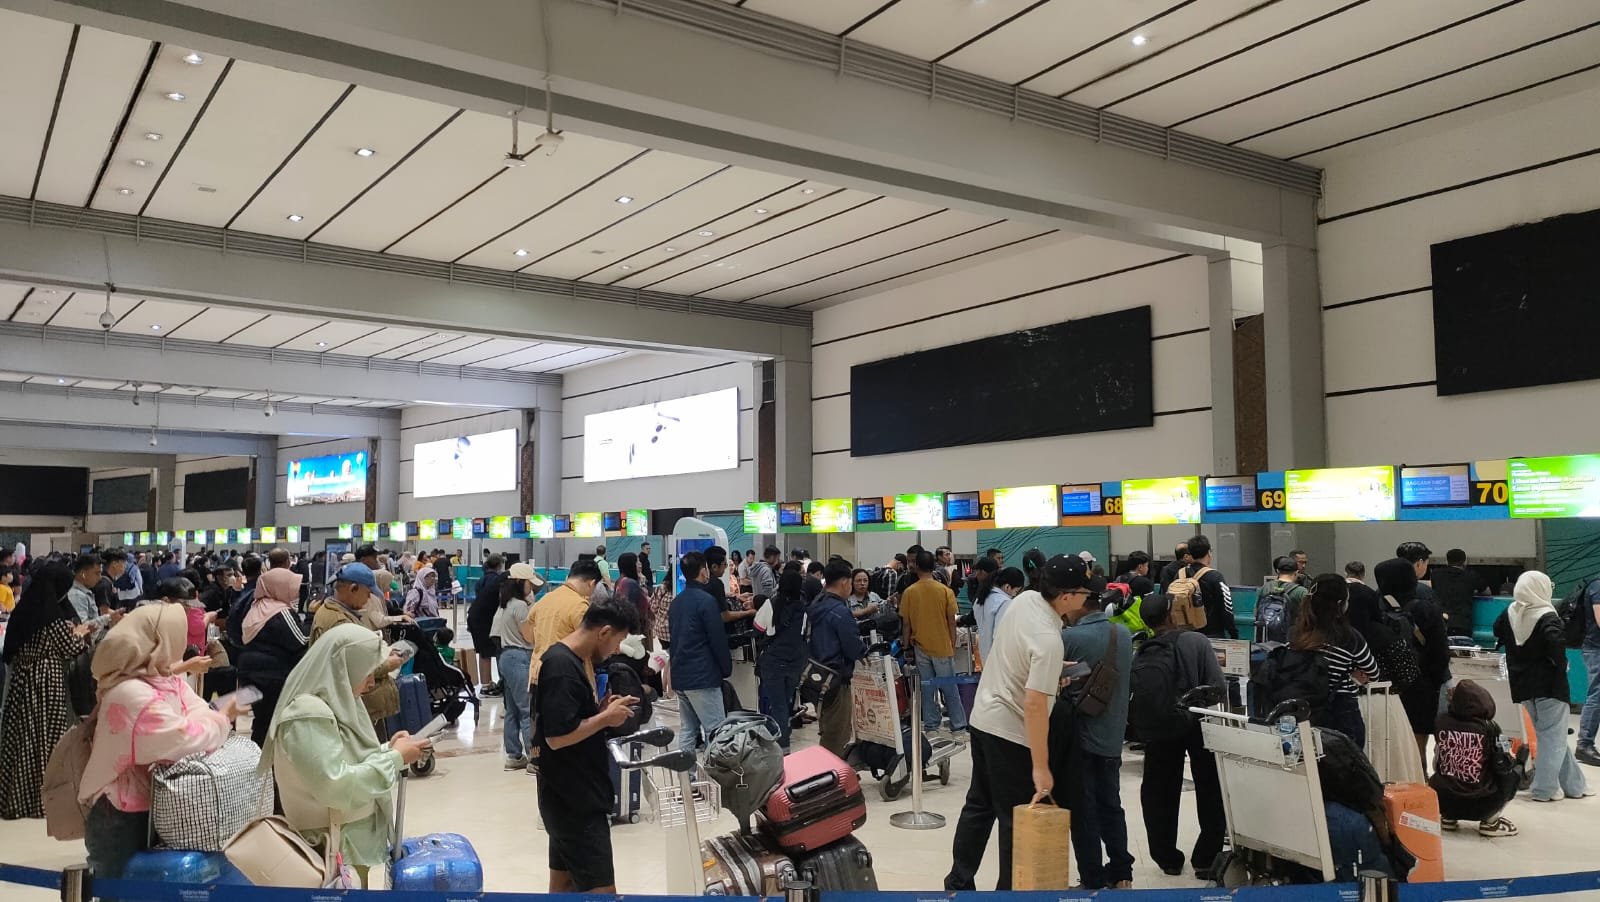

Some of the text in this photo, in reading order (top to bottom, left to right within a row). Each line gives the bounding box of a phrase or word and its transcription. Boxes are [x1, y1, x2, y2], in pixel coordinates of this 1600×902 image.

[1261, 490, 1286, 509] 69
[1476, 482, 1508, 503] 70
[1105, 497, 1123, 514] 68
[1439, 730, 1485, 750] CARTEX
